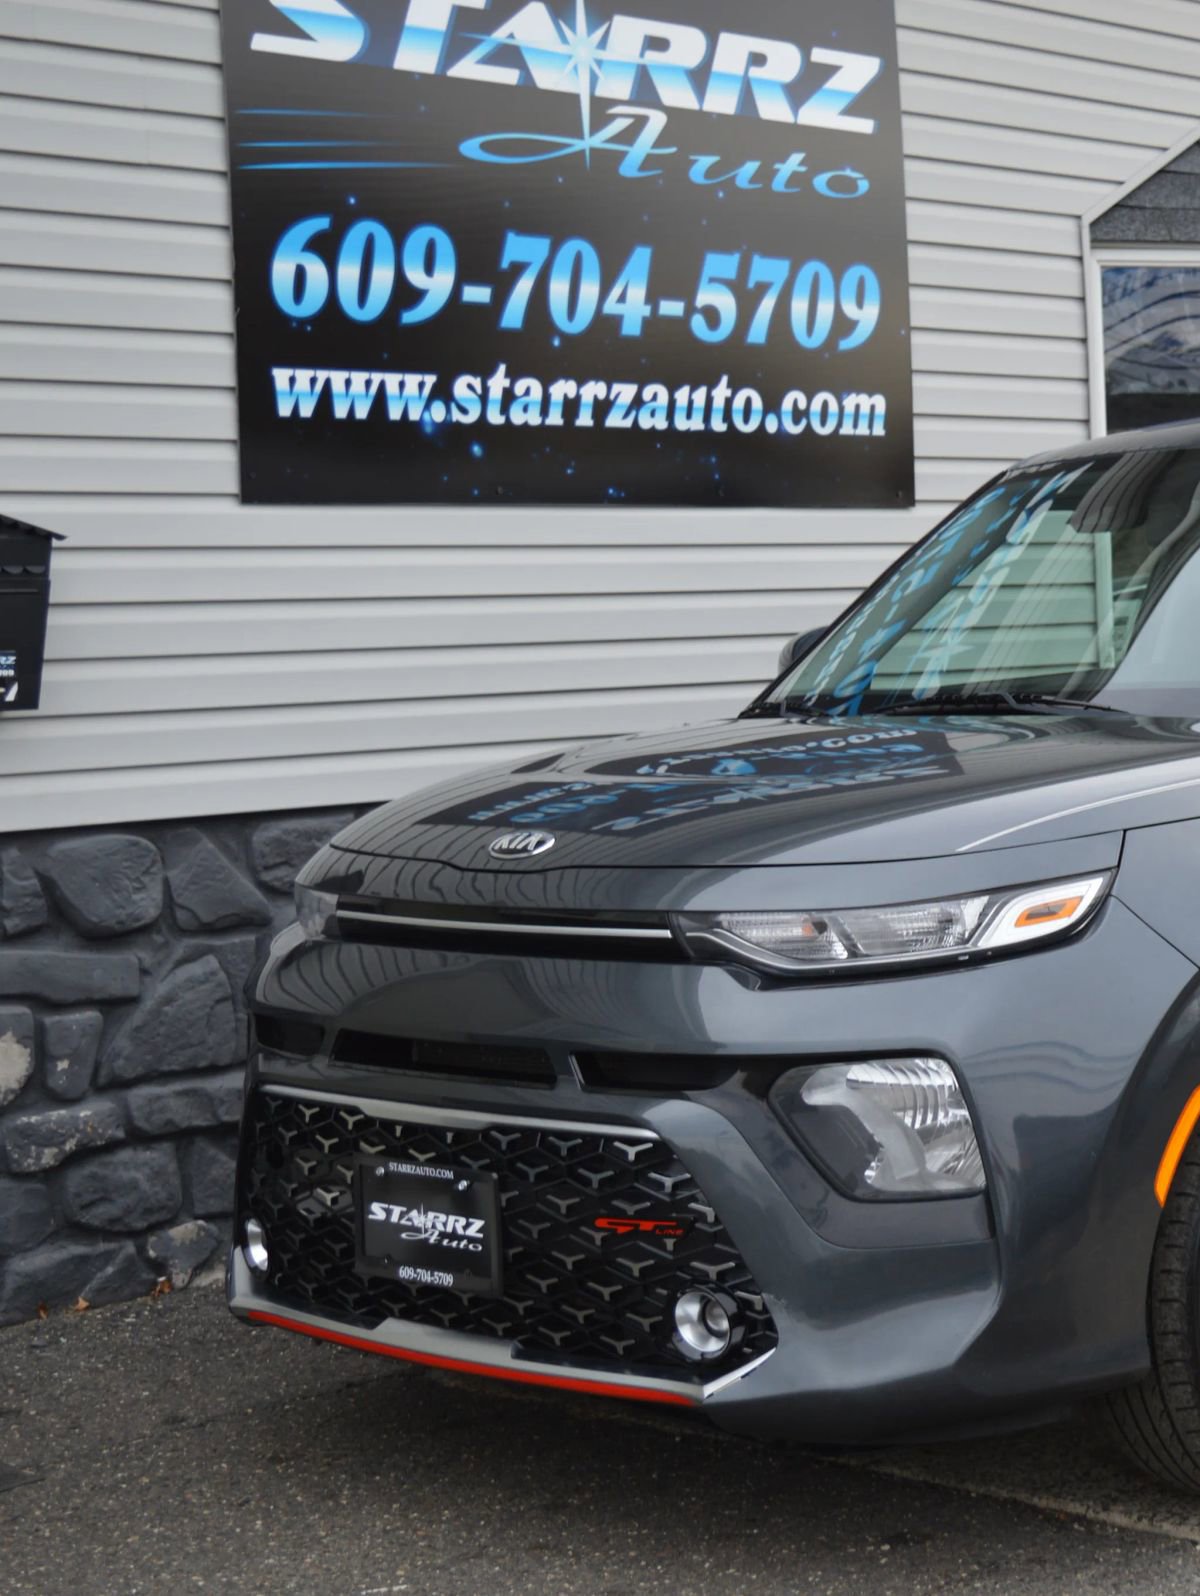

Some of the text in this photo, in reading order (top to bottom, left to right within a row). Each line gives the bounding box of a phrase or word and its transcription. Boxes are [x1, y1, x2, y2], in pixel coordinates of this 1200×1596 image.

[249, 0, 884, 134] STARRZ
[458, 105, 870, 198] Auto
[270, 215, 881, 351] 609-704-5709
[271, 363, 886, 436] www.starrzauto.com
[493, 832, 543, 851] KIA
[389, 1162, 454, 1179] STARRZAUTO.COM
[368, 1201, 485, 1238] STARRZ
[594, 1217, 677, 1234] GT
[401, 1229, 482, 1251] Auto
[399, 1266, 454, 1287] 609-704-5709
